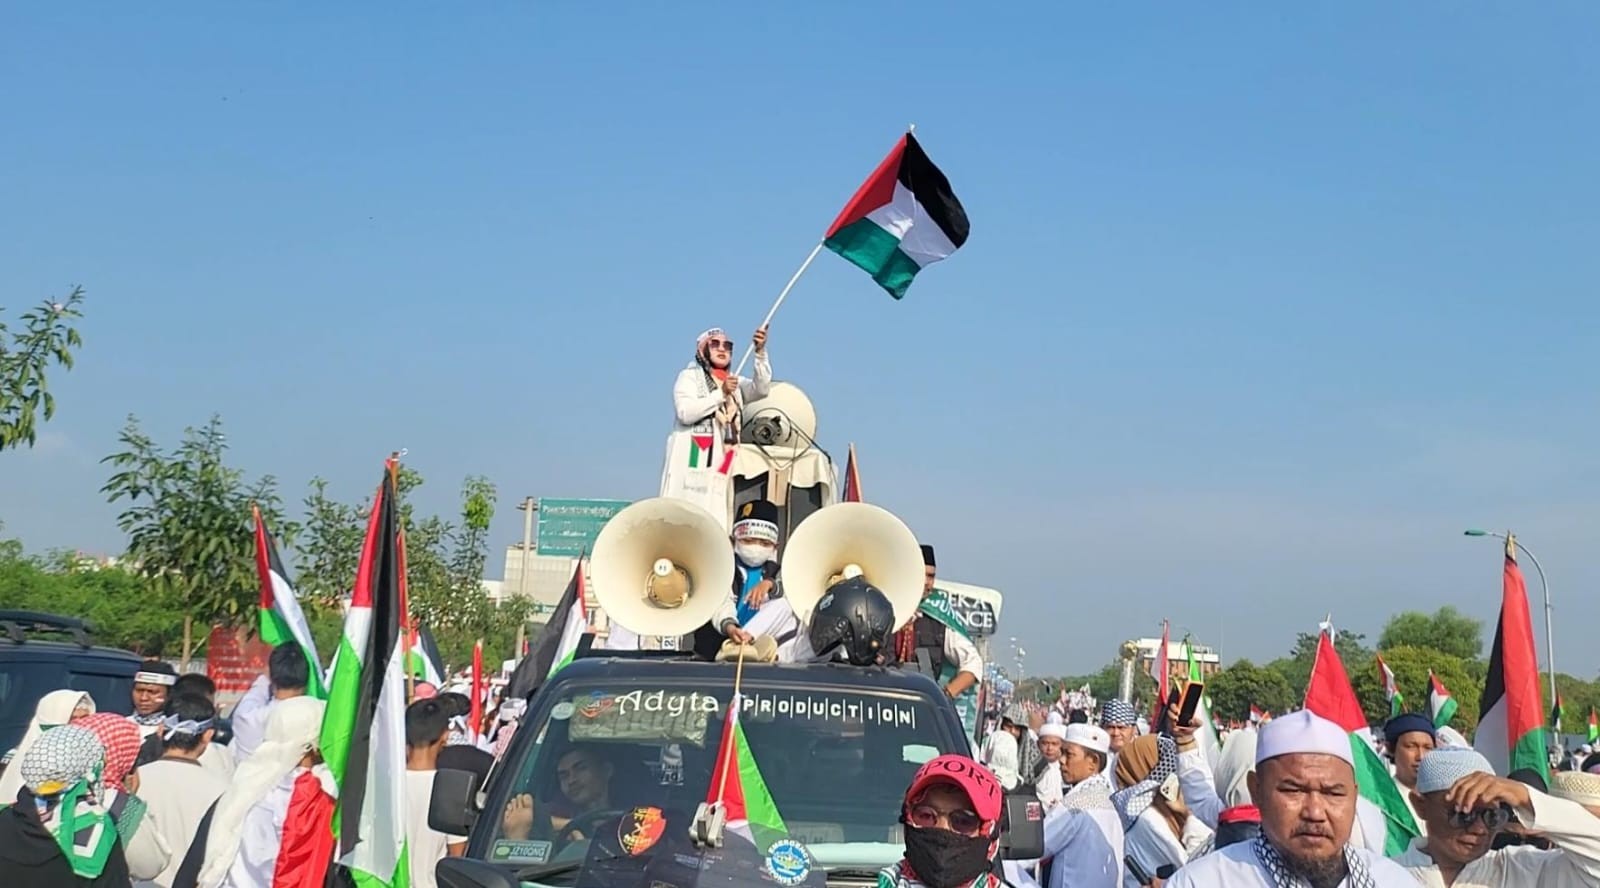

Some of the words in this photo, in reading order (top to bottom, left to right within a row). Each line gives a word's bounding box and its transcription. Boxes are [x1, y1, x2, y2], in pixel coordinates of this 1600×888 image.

[948, 592, 986, 609] EKA
[957, 611, 993, 628] NCE
[614, 689, 719, 717] Adyta
